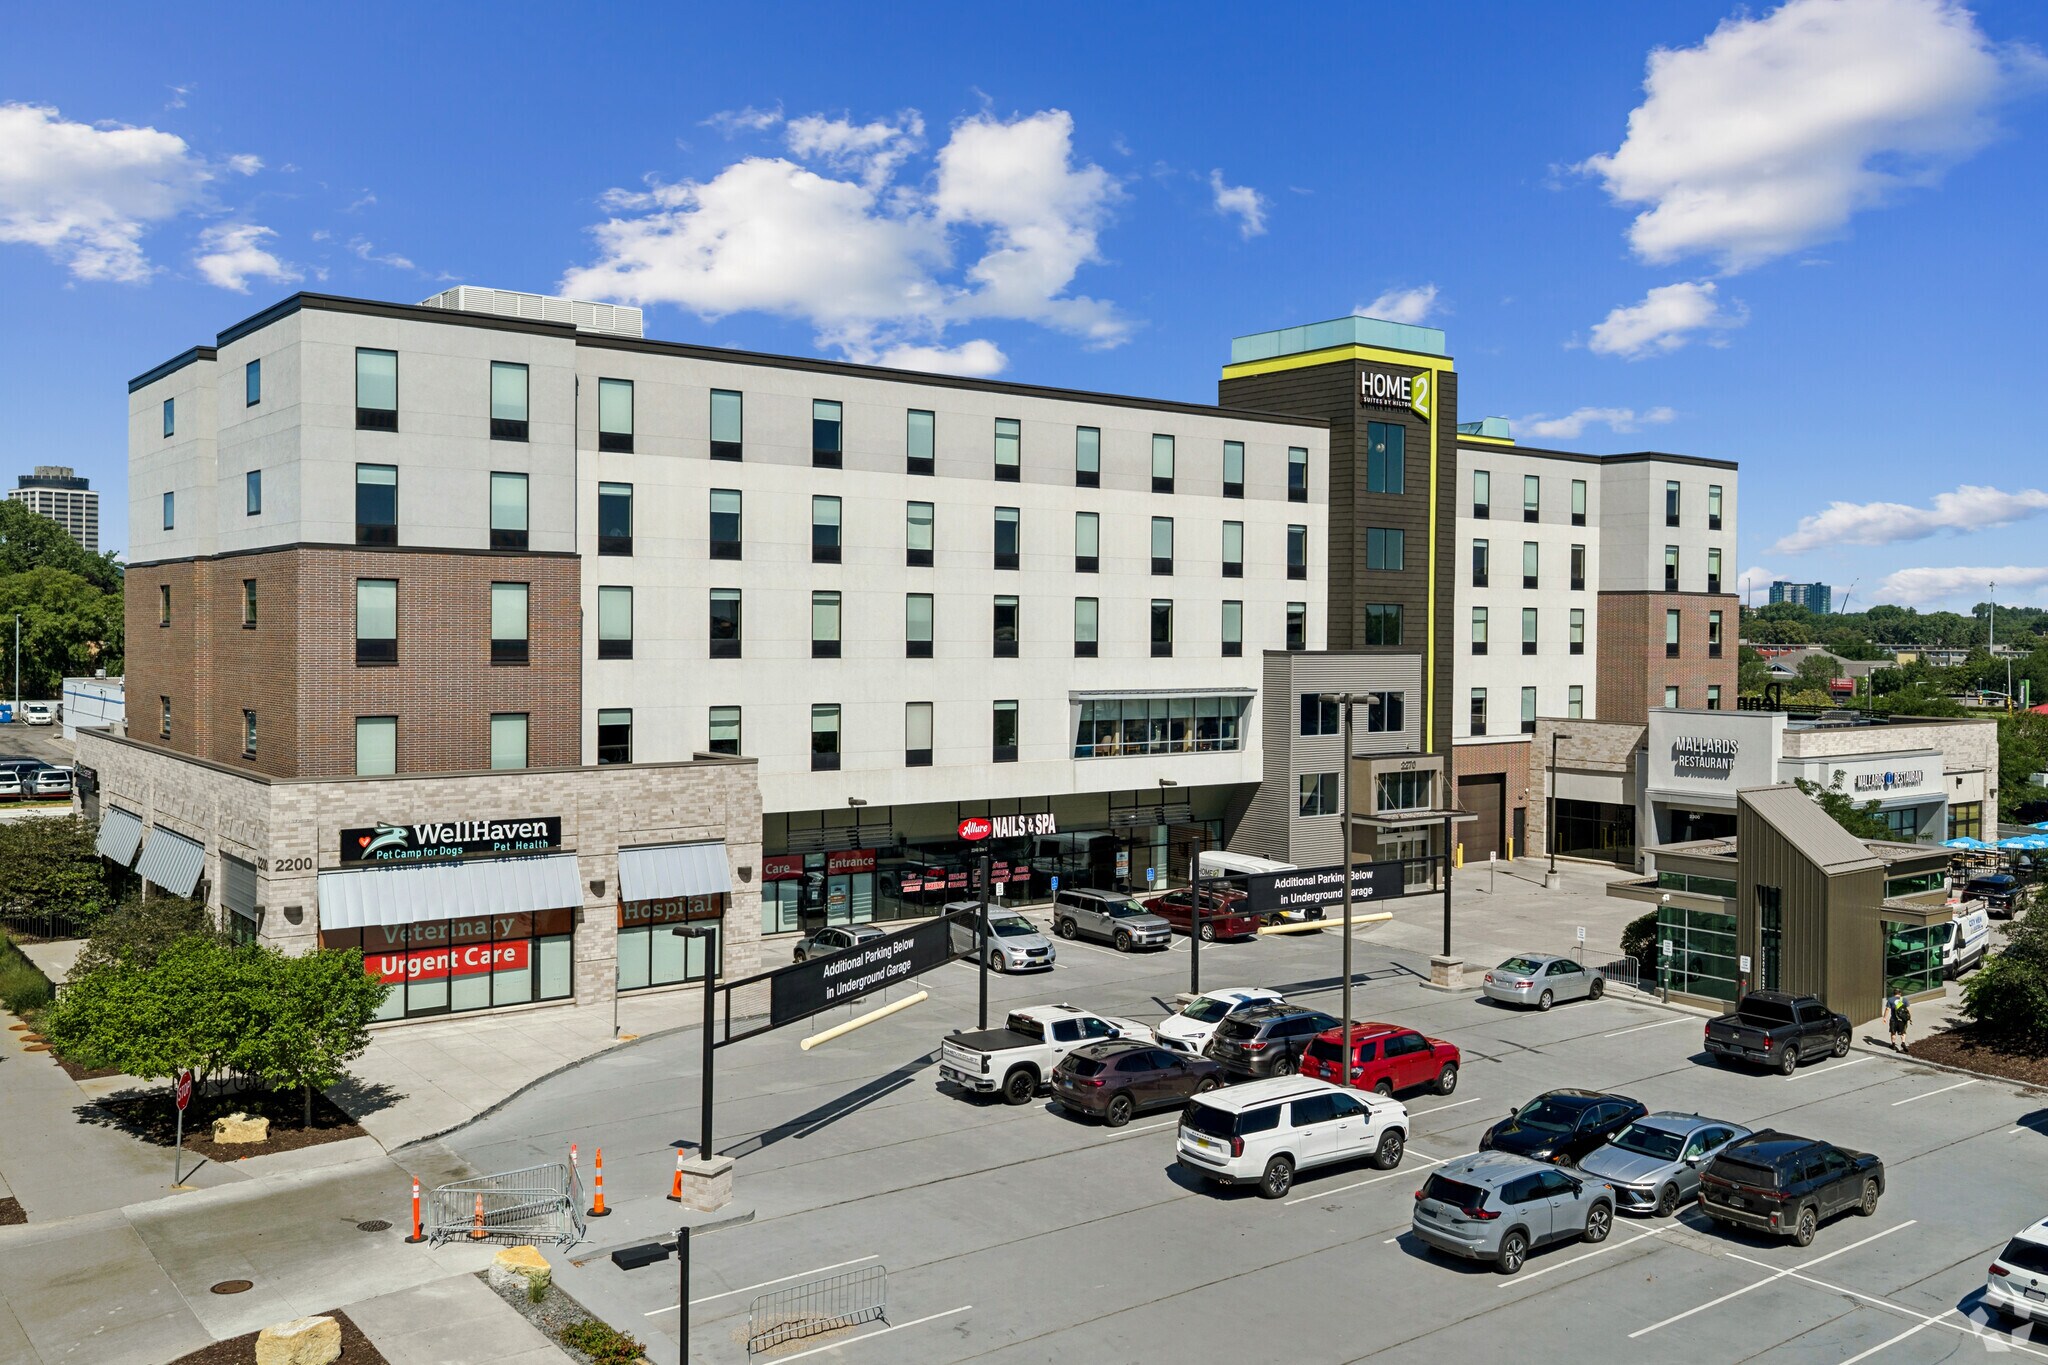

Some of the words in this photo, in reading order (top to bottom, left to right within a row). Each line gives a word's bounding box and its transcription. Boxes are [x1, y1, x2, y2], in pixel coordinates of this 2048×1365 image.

[1361, 371, 1411, 400] HOME
[1415, 377, 1428, 414] 2
[1363, 396, 1383, 404] SUITES
[1392, 400, 1411, 408] HILTON
[1676, 736, 1738, 755] MALLARDS
[1400, 760, 1416, 770] 2270
[1679, 755, 1734, 770] RESTAURANT
[1893, 770, 1923, 785] RESTAURANT
[413, 820, 549, 845] WellHaven
[962, 821, 988, 836] Allure
[992, 815, 1026, 838] NAILS
[1028, 818, 1034, 832] &
[1035, 813, 1056, 835] SPA
[376, 850, 393, 860] Pet
[394, 849, 422, 860] Camp
[423, 847, 438, 857] for
[440, 846, 463, 857] Dogs
[494, 842, 510, 851] Pet
[516, 839, 549, 850] Health
[275, 857, 313, 872] 2200
[765, 863, 790, 874] Care
[829, 857, 874, 869] Entrance
[1274, 875, 1316, 889] Additional
[1280, 894, 1289, 904] in
[1290, 888, 1343, 903] Underground
[1350, 886, 1373, 897] arage
[624, 894, 713, 920] Hospital
[381, 949, 459, 977] Urgent
[464, 947, 516, 966] Care
[823, 953, 864, 978] Additional
[865, 946, 892, 964] Parking
[893, 938, 915, 954] Below
[826, 986, 835, 999] in
[836, 966, 885, 996] Underground
[886, 960, 911, 977] Garage
[178, 1080, 191, 1101] STOP
